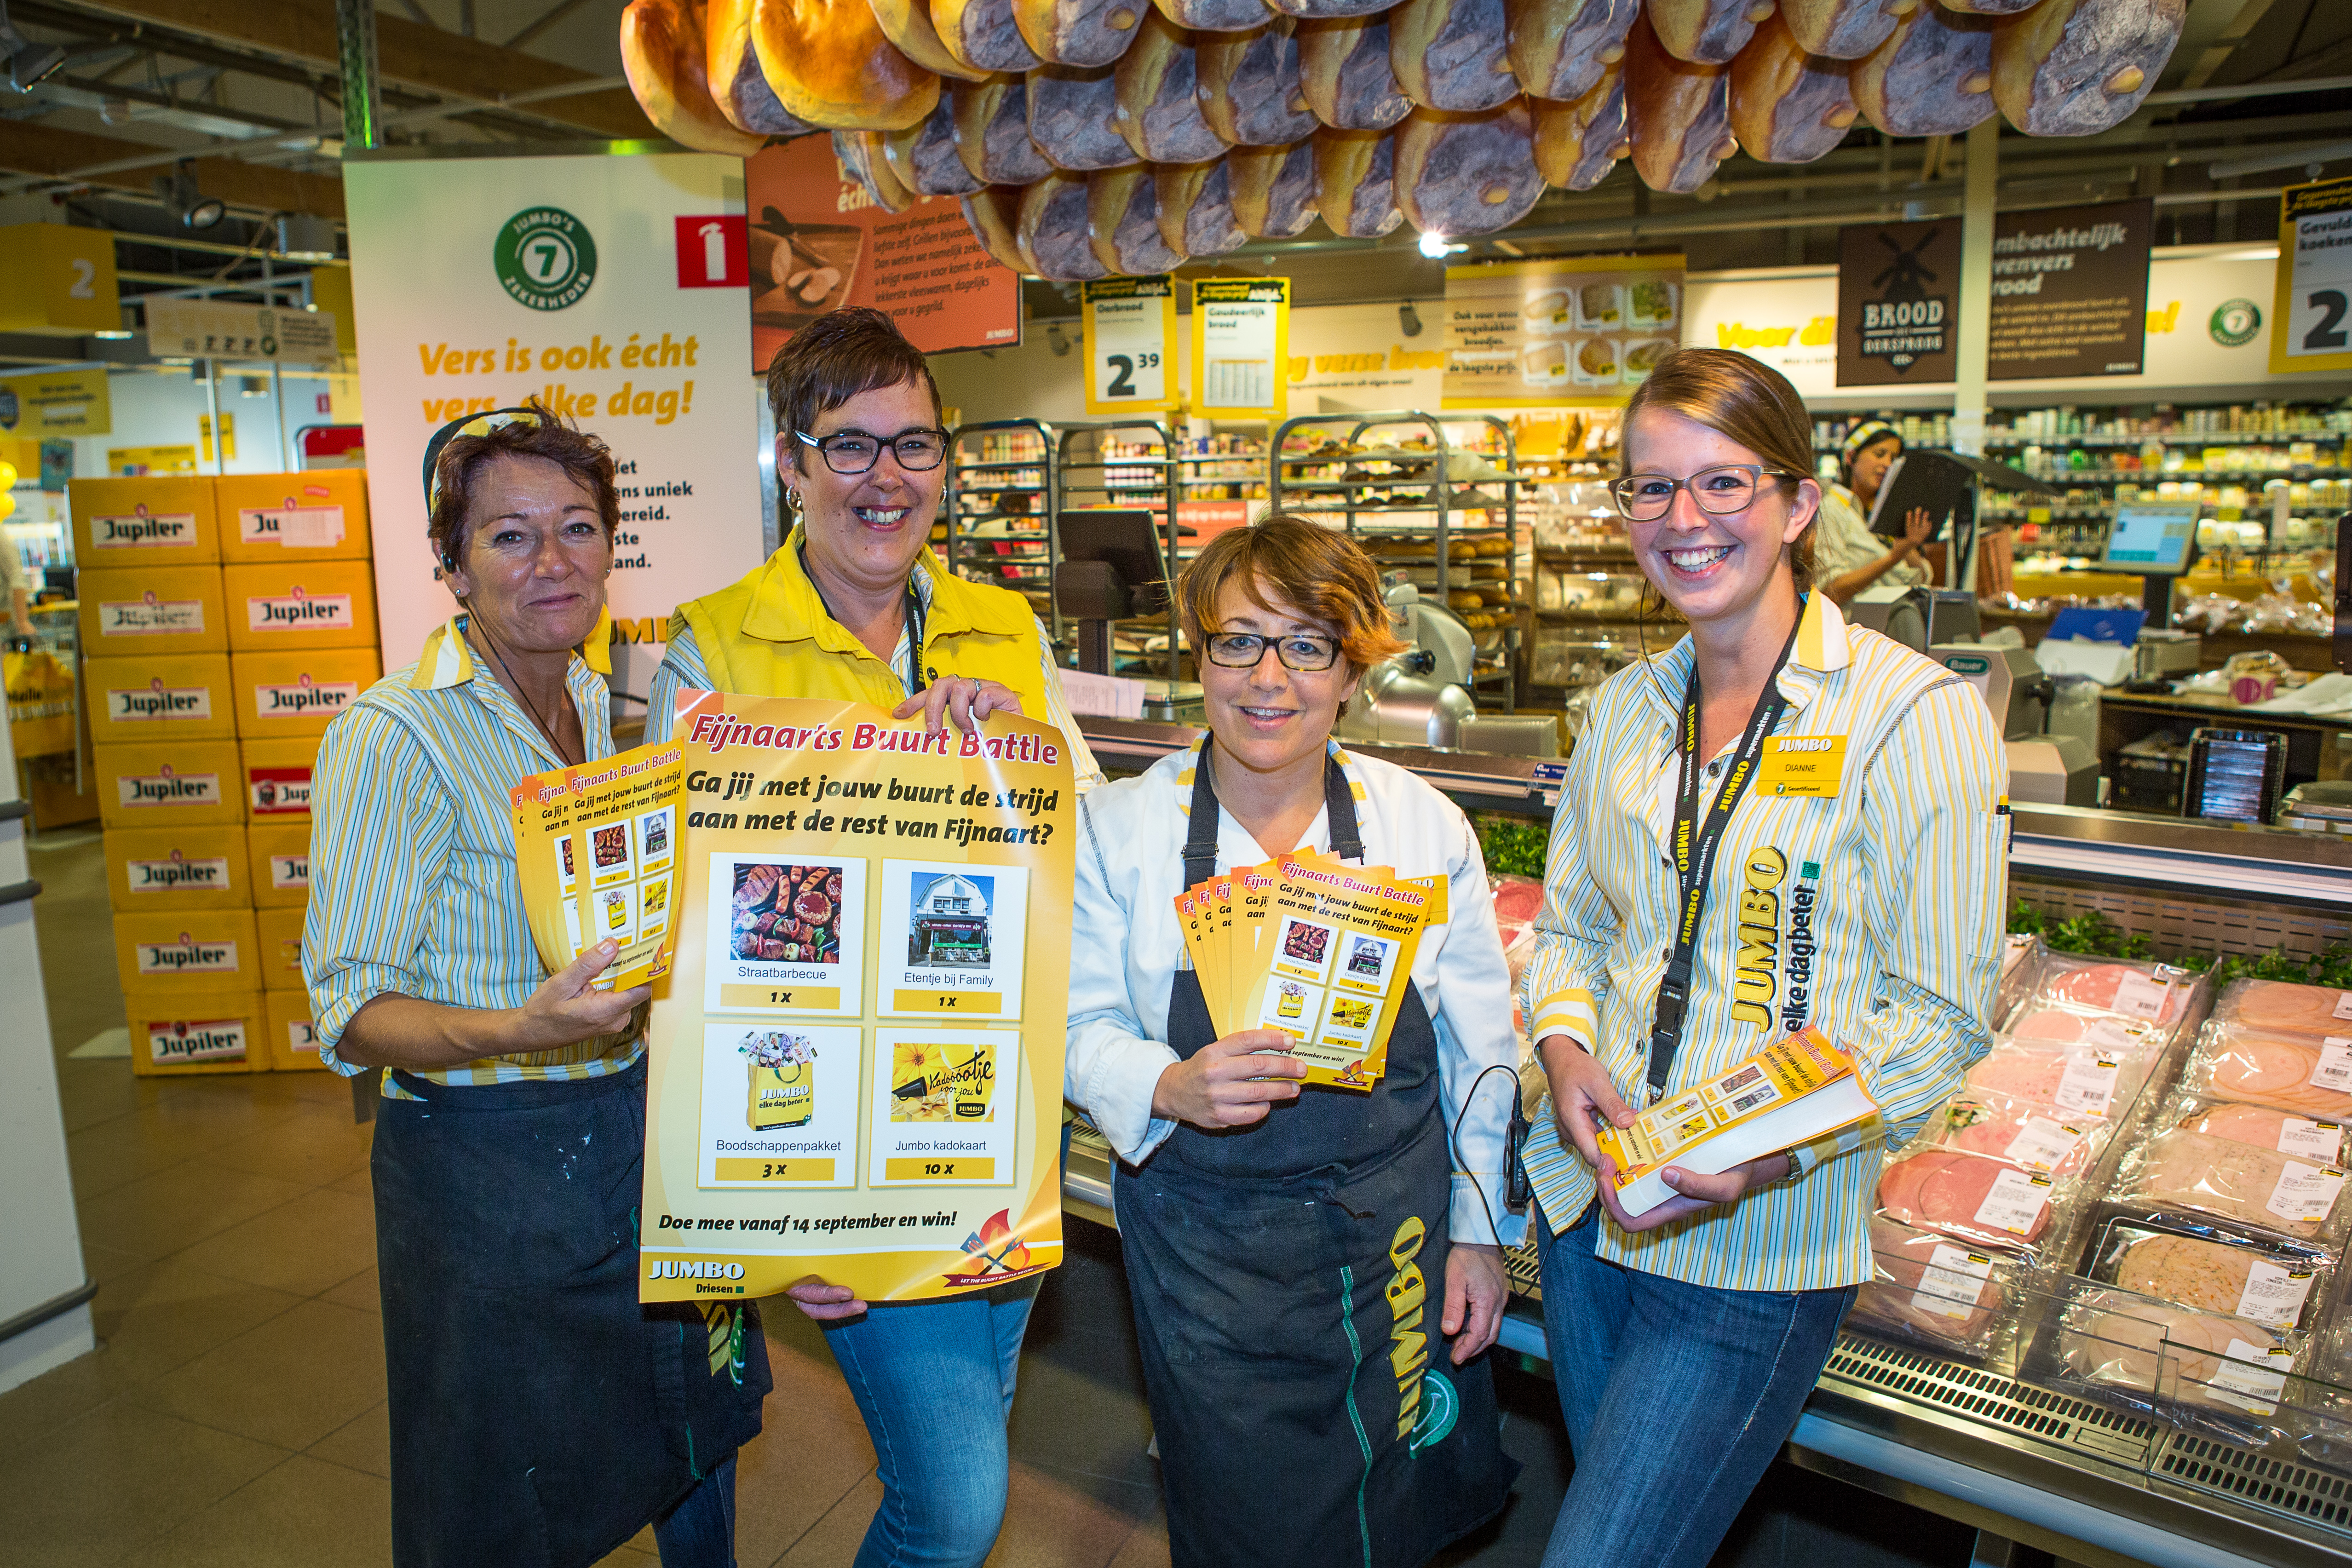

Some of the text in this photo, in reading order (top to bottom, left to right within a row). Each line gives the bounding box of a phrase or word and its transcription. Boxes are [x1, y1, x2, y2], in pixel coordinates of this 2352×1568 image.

[512, 212, 575, 234] JUMBO'S
[1994, 223, 2128, 254] mbachtelijk
[535, 245, 557, 277] 7
[1993, 253, 2076, 276] venvers
[70, 259, 95, 299] 2
[505, 272, 590, 308] ZEKERHEDEN
[1991, 272, 2044, 296] rood
[1864, 300, 1944, 329] BROOD
[2302, 289, 2348, 350] 2
[1717, 322, 1795, 349] Voor
[419, 332, 700, 376] Vers is ook écht
[1107, 353, 1160, 397] 2 39
[422, 398, 498, 423] vers
[607, 381, 695, 425] dag!
[645, 481, 694, 497] uniek
[620, 507, 671, 521] ereid.
[104, 518, 184, 542] Jupiler
[262, 601, 339, 623] Jupiler
[1950, 659, 1983, 671] Bauer
[121, 689, 347, 715] Jupiler Jupiler
[689, 712, 1059, 766] Fijnaarts Buurt Battle
[1777, 738, 1833, 752] JUMBO
[571, 747, 682, 794] Fijnaarts Buurt Battle
[1718, 712, 1772, 813] JUMBO supermarkten
[1785, 764, 1817, 772] DIANNE
[131, 779, 208, 801] Jupiler
[574, 770, 681, 809] Ga jij met jouw buurt de strijd
[687, 770, 1059, 817] Ga jij met jouw buurt de strijd
[577, 784, 681, 822] aan met de rest van Fijnaart?
[688, 810, 1055, 847] aan met de rest van Fijnaart?
[1677, 819, 1691, 872] JUMBO
[140, 862, 218, 885] Jupiler
[599, 865, 625, 874] Straatbarbecue
[1282, 862, 1426, 907] Fijnaarts Buurt Battle
[1681, 836, 1714, 946] JUMBO supermarkten
[1279, 883, 1420, 925] Ga jij met jouw buurt de strijd
[1277, 898, 1414, 936] aan met de rest van Fijnaart?
[1731, 845, 1788, 1034] JUMBO
[150, 945, 226, 967] Jupiler
[1284, 957, 1317, 969] Straatbarbecue
[1785, 885, 1817, 1032] elke dag beter
[738, 966, 827, 980] Straatbarbecue
[904, 971, 994, 988] Etentje bij Family
[771, 991, 792, 1004] 1 X
[938, 996, 957, 1007] 1 X
[1264, 1016, 1310, 1030] Boodschappenpakket
[156, 1030, 238, 1057] Jupiler
[1808, 1047, 1829, 1065] Buurt
[759, 1085, 810, 1100] JUMBO
[716, 1139, 841, 1154] Boodschappenpakket
[895, 1139, 987, 1151] Jumbo kadokaart
[762, 1163, 788, 1178] 3 X
[924, 1163, 955, 1175] 10 X
[658, 1211, 958, 1235] Doe mee vanaf 14 september en win!
[648, 1260, 746, 1280] JUMBO
[999, 1271, 1017, 1280] BATTLE
[696, 1283, 733, 1294] Driesen
